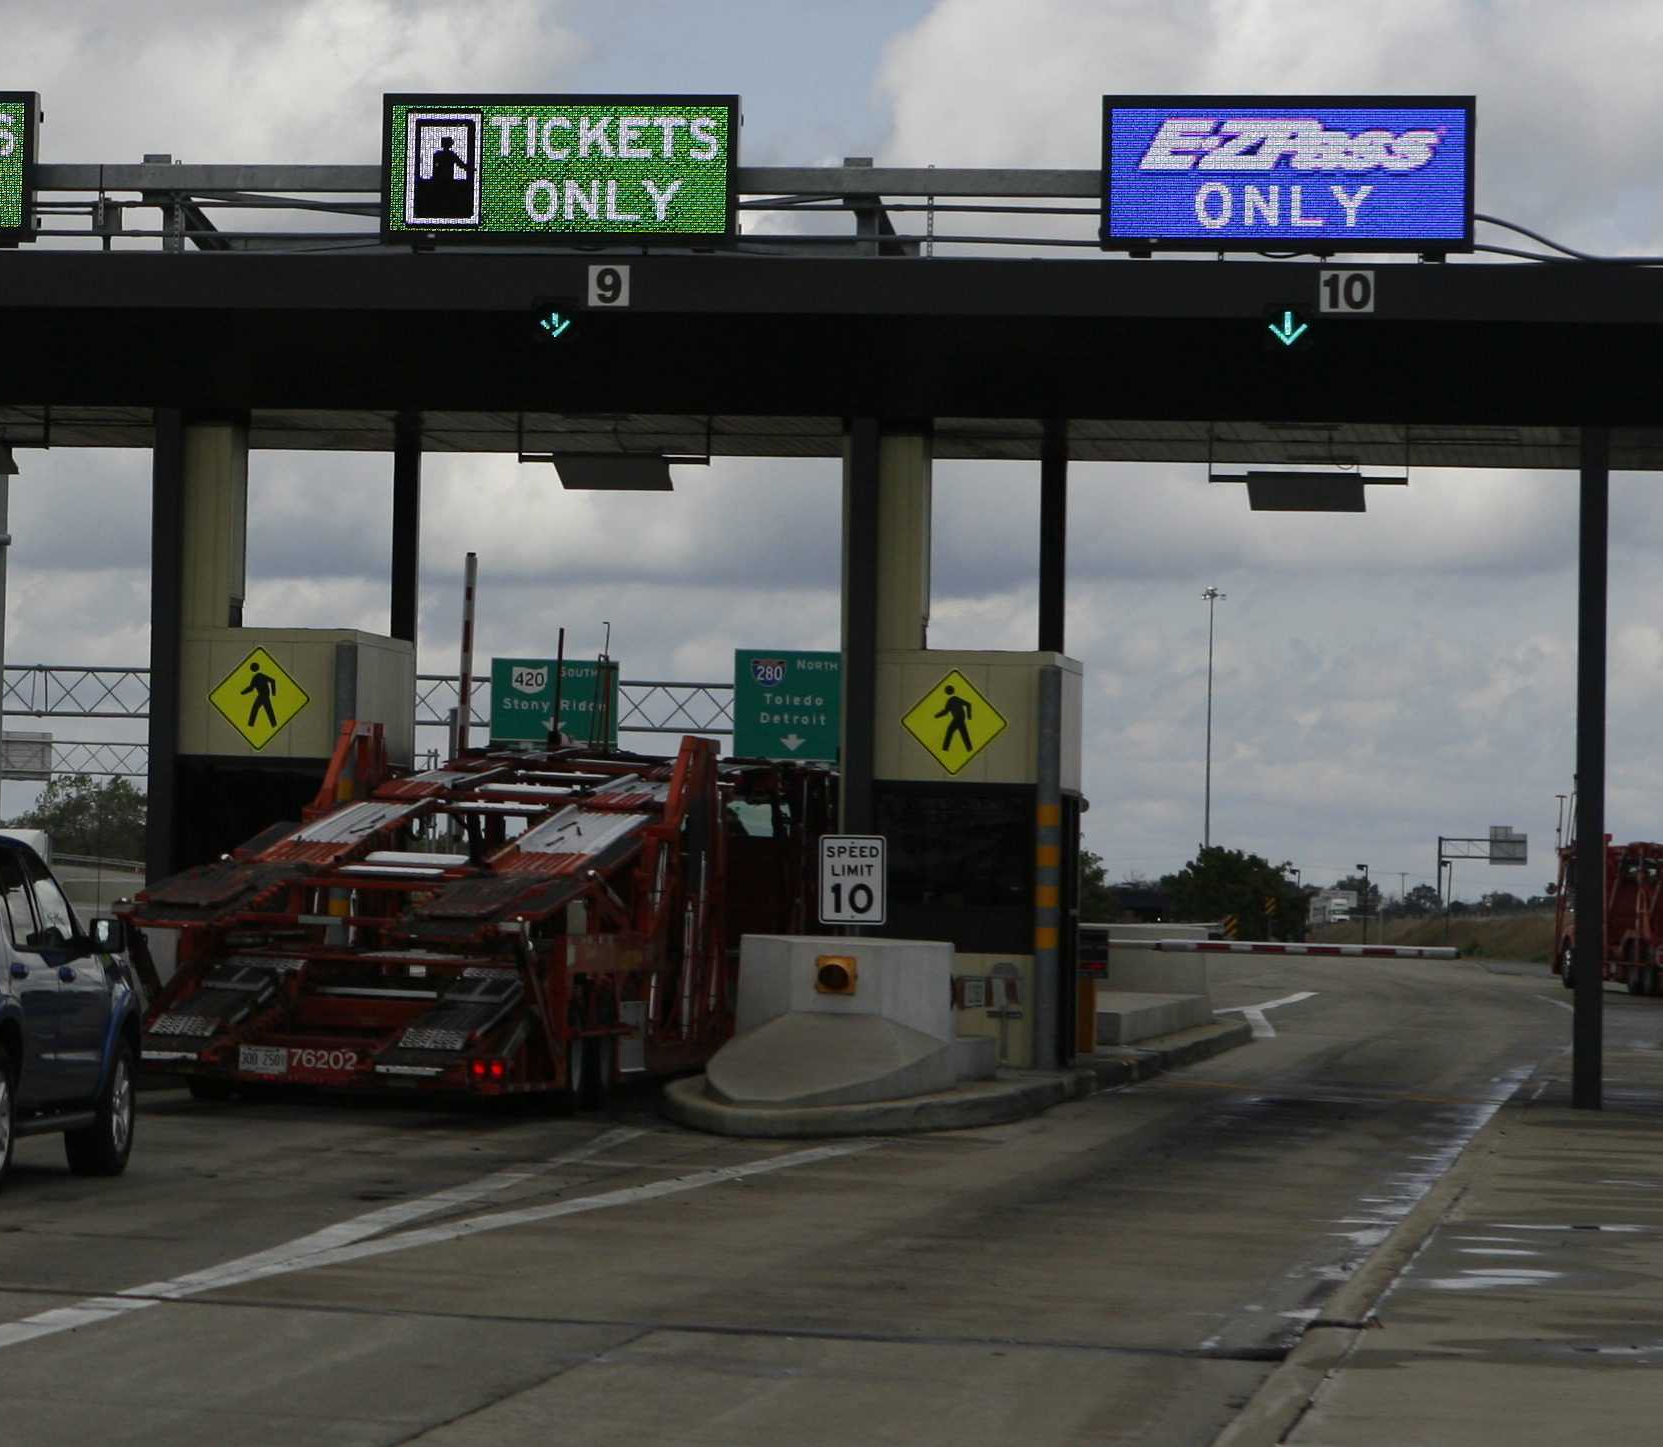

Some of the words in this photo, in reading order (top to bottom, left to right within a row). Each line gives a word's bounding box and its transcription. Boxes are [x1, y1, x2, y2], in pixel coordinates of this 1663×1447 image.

[491, 116, 721, 160] TICKETS
[524, 179, 684, 222] ONLY
[1193, 182, 1374, 228] ONLY
[595, 268, 622, 304] 9
[1323, 273, 1372, 310] 10
[514, 672, 545, 687] 420
[560, 667, 599, 678] SOUTH
[756, 666, 783, 681] 280
[796, 660, 838, 671] NORTH
[502, 698, 551, 713] Stony
[764, 693, 824, 706] Toledo
[760, 712, 826, 725] Detroit
[826, 846, 879, 858] SPEED
[831, 865, 874, 876] LIMIT
[831, 883, 874, 914] 10
[290, 1048, 358, 1070] 76202
